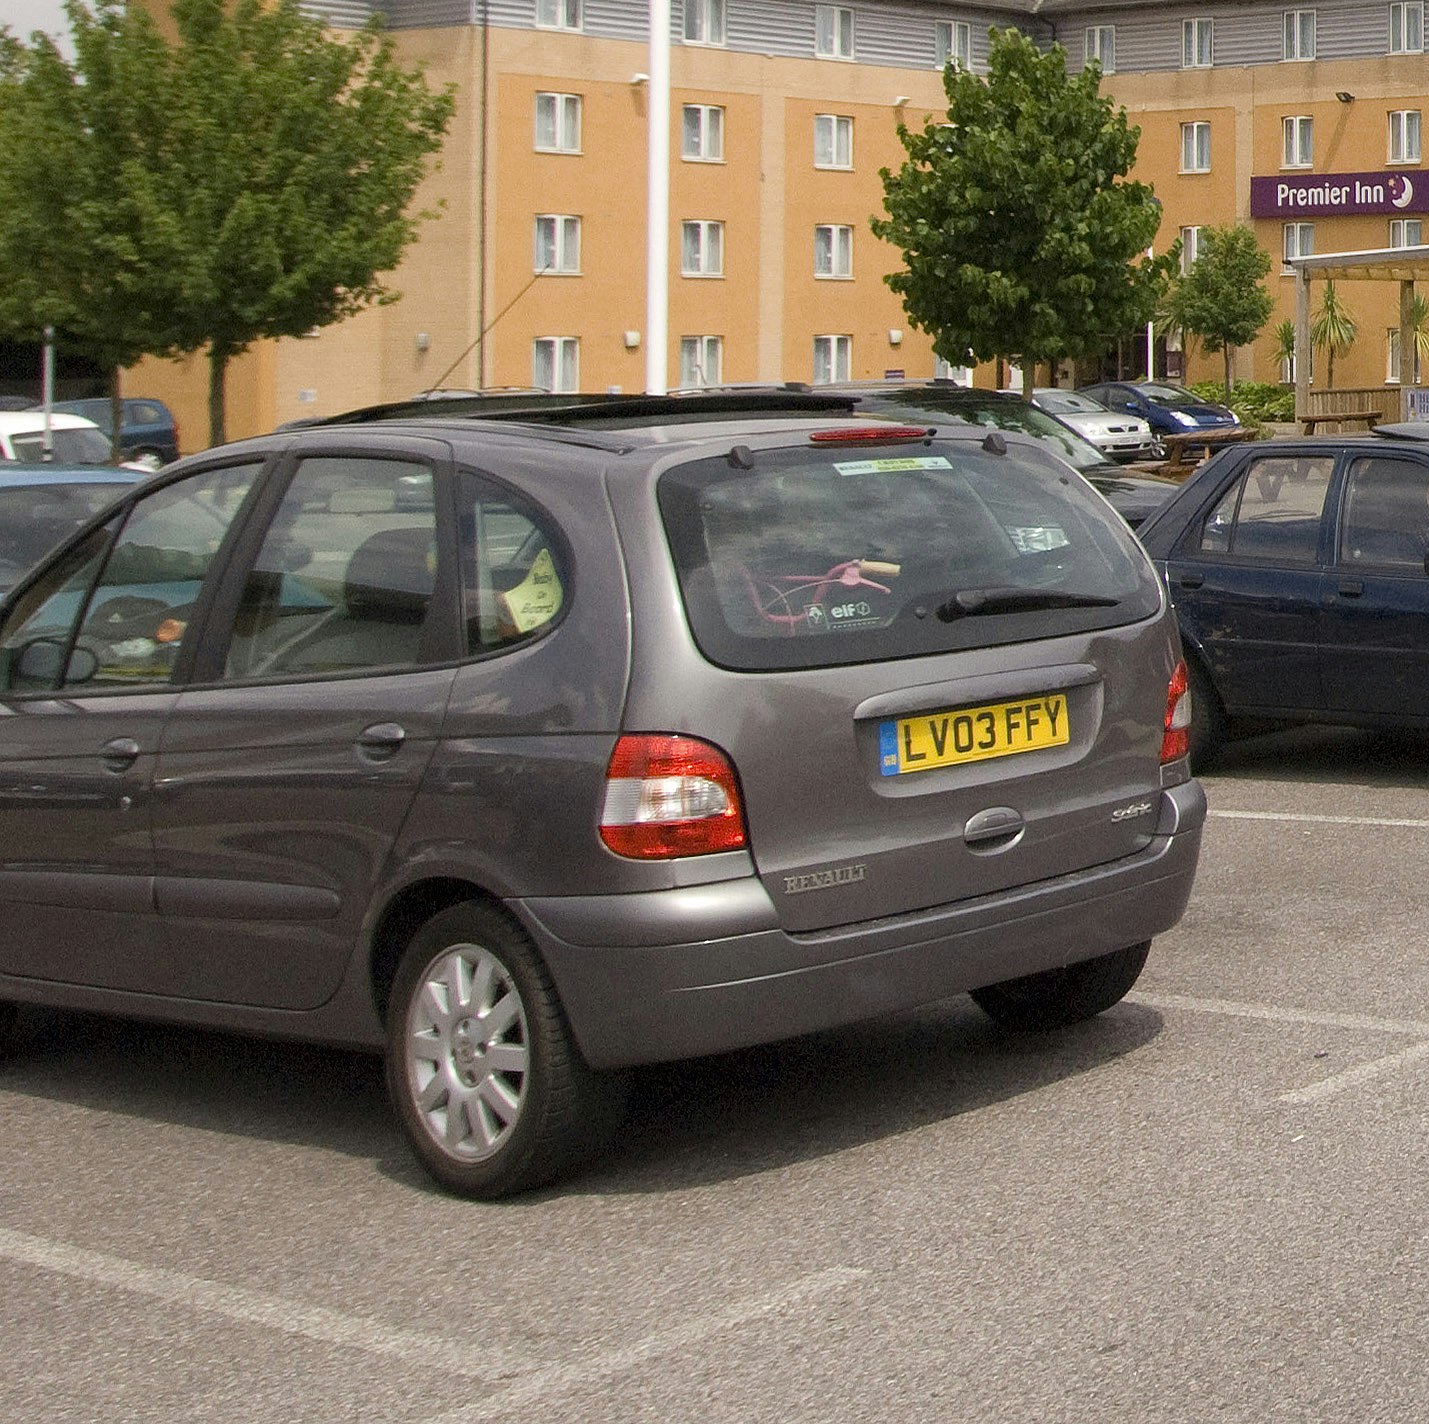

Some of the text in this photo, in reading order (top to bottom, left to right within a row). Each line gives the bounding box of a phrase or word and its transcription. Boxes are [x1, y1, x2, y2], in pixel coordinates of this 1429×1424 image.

[1277, 181, 1384, 207] Premier Inn
[831, 603, 855, 618] elf
[903, 700, 1061, 762] LV03 FFY
[783, 864, 866, 895] RENAULT
